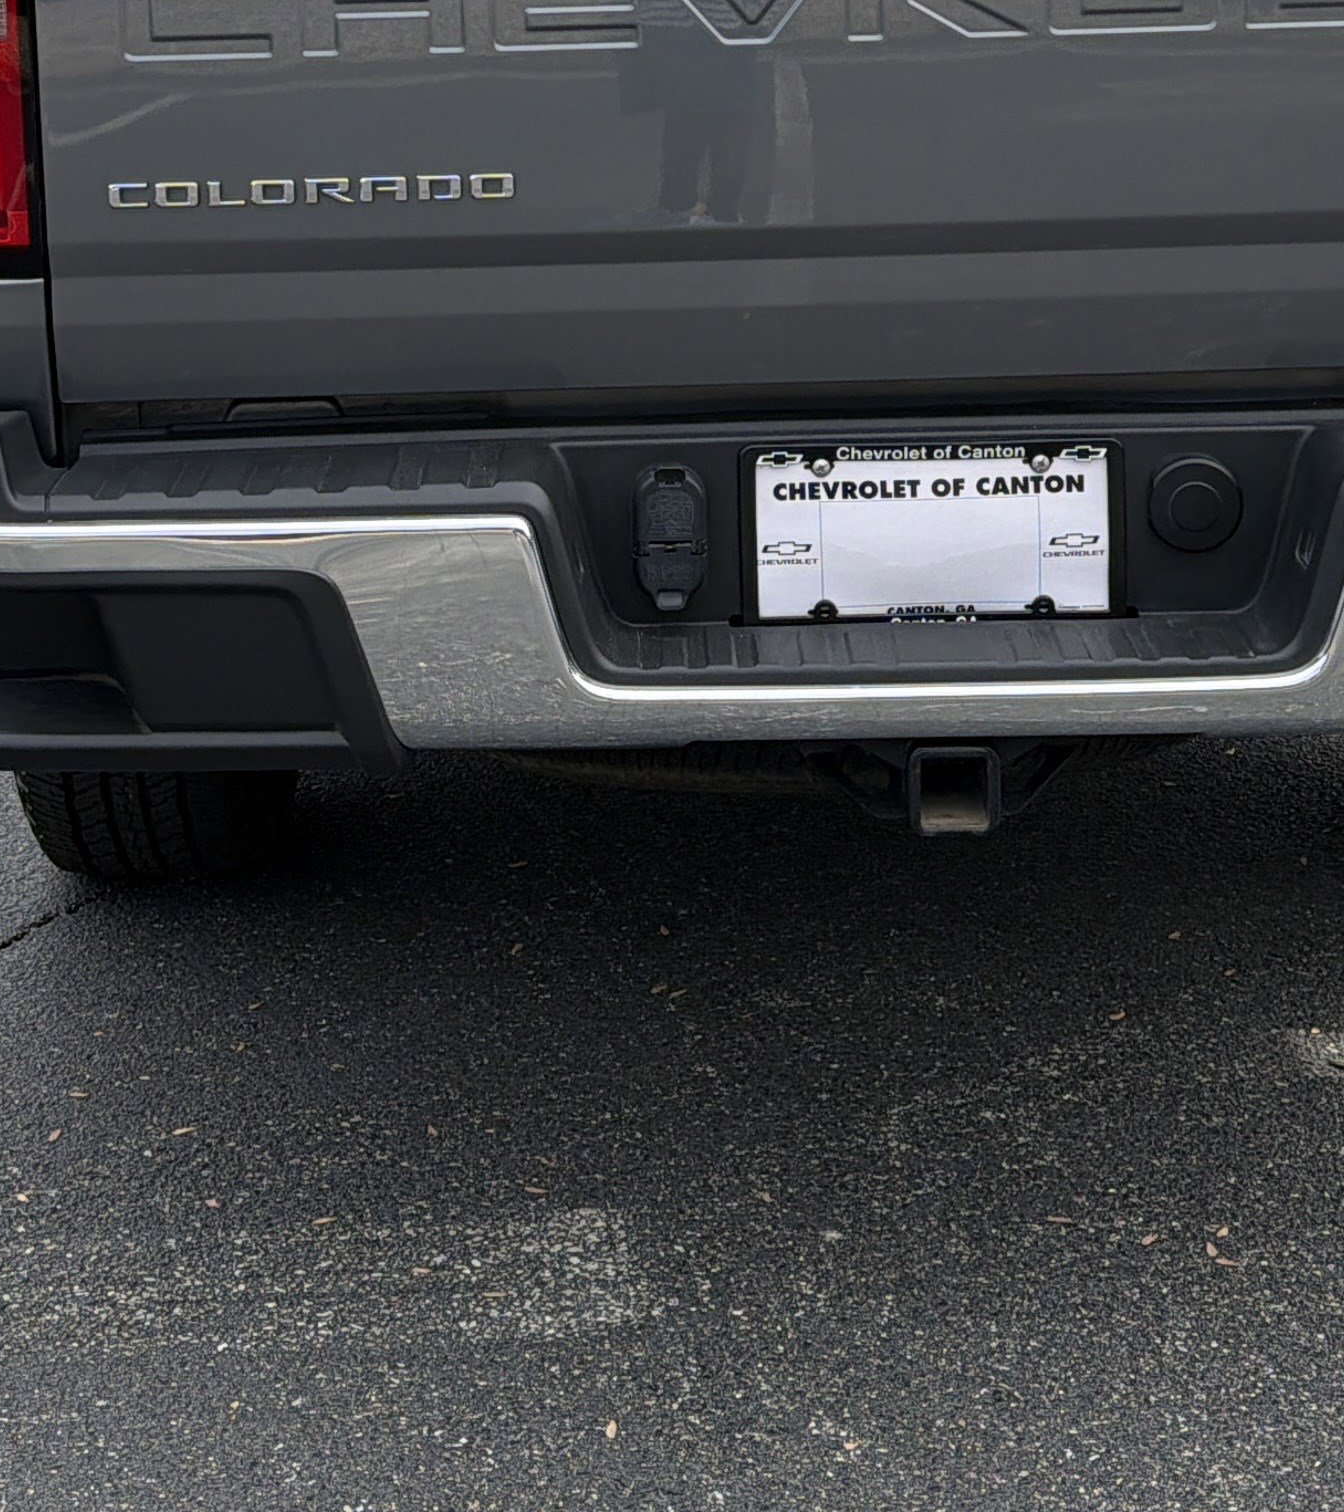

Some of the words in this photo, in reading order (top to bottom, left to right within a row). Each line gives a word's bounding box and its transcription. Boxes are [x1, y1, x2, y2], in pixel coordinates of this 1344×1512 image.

[108, 172, 515, 208] COLORADO
[836, 446, 926, 461] Chevrolet
[933, 446, 953, 459] of
[957, 445, 1026, 459] Canton
[773, 479, 920, 501] CHEVROLET
[931, 478, 965, 496] OF
[976, 474, 1085, 495] CANTON
[1043, 550, 1105, 558] CHEVROLET
[955, 605, 976, 613] GA
